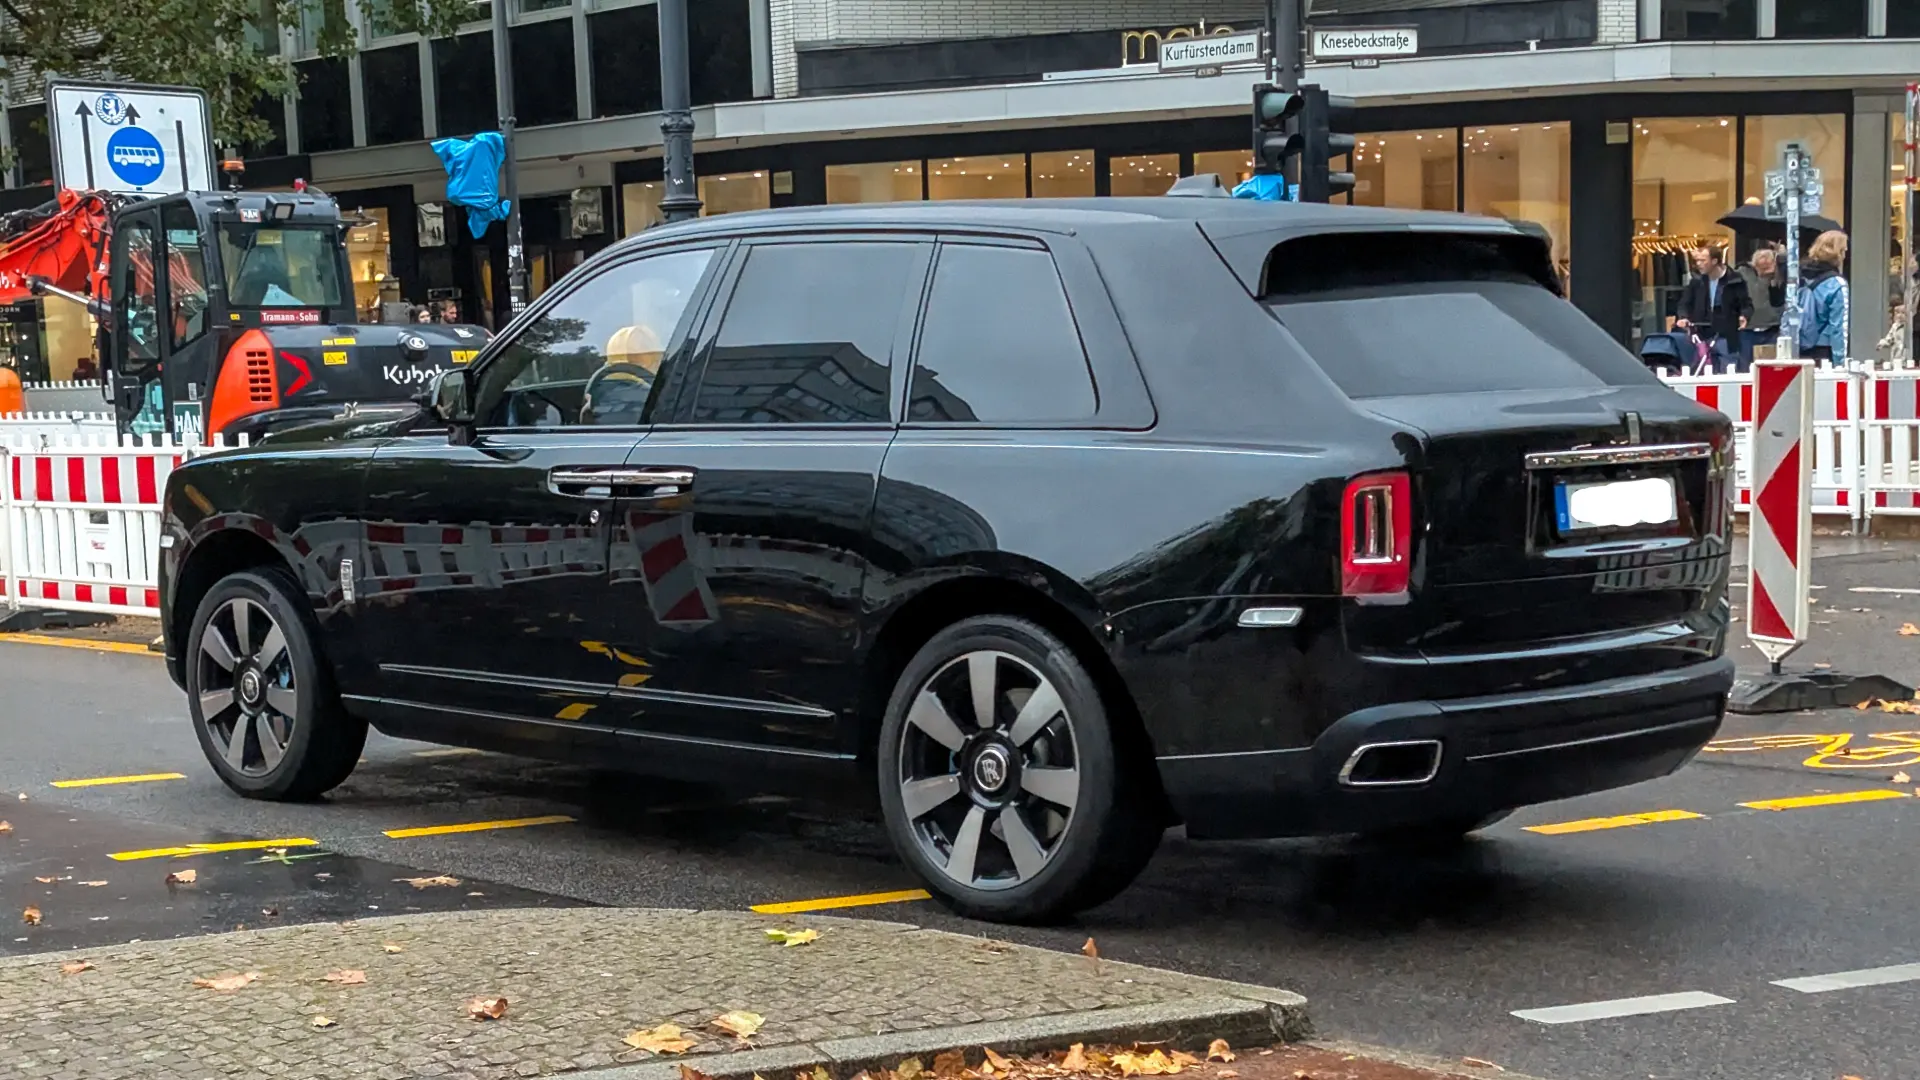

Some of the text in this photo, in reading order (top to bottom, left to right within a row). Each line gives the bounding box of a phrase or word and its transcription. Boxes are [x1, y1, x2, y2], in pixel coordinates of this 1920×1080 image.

[1165, 41, 1255, 61] Kurfürstendamm
[1321, 32, 1409, 50] Knesebeckstraße
[175, 410, 201, 433] HAN
